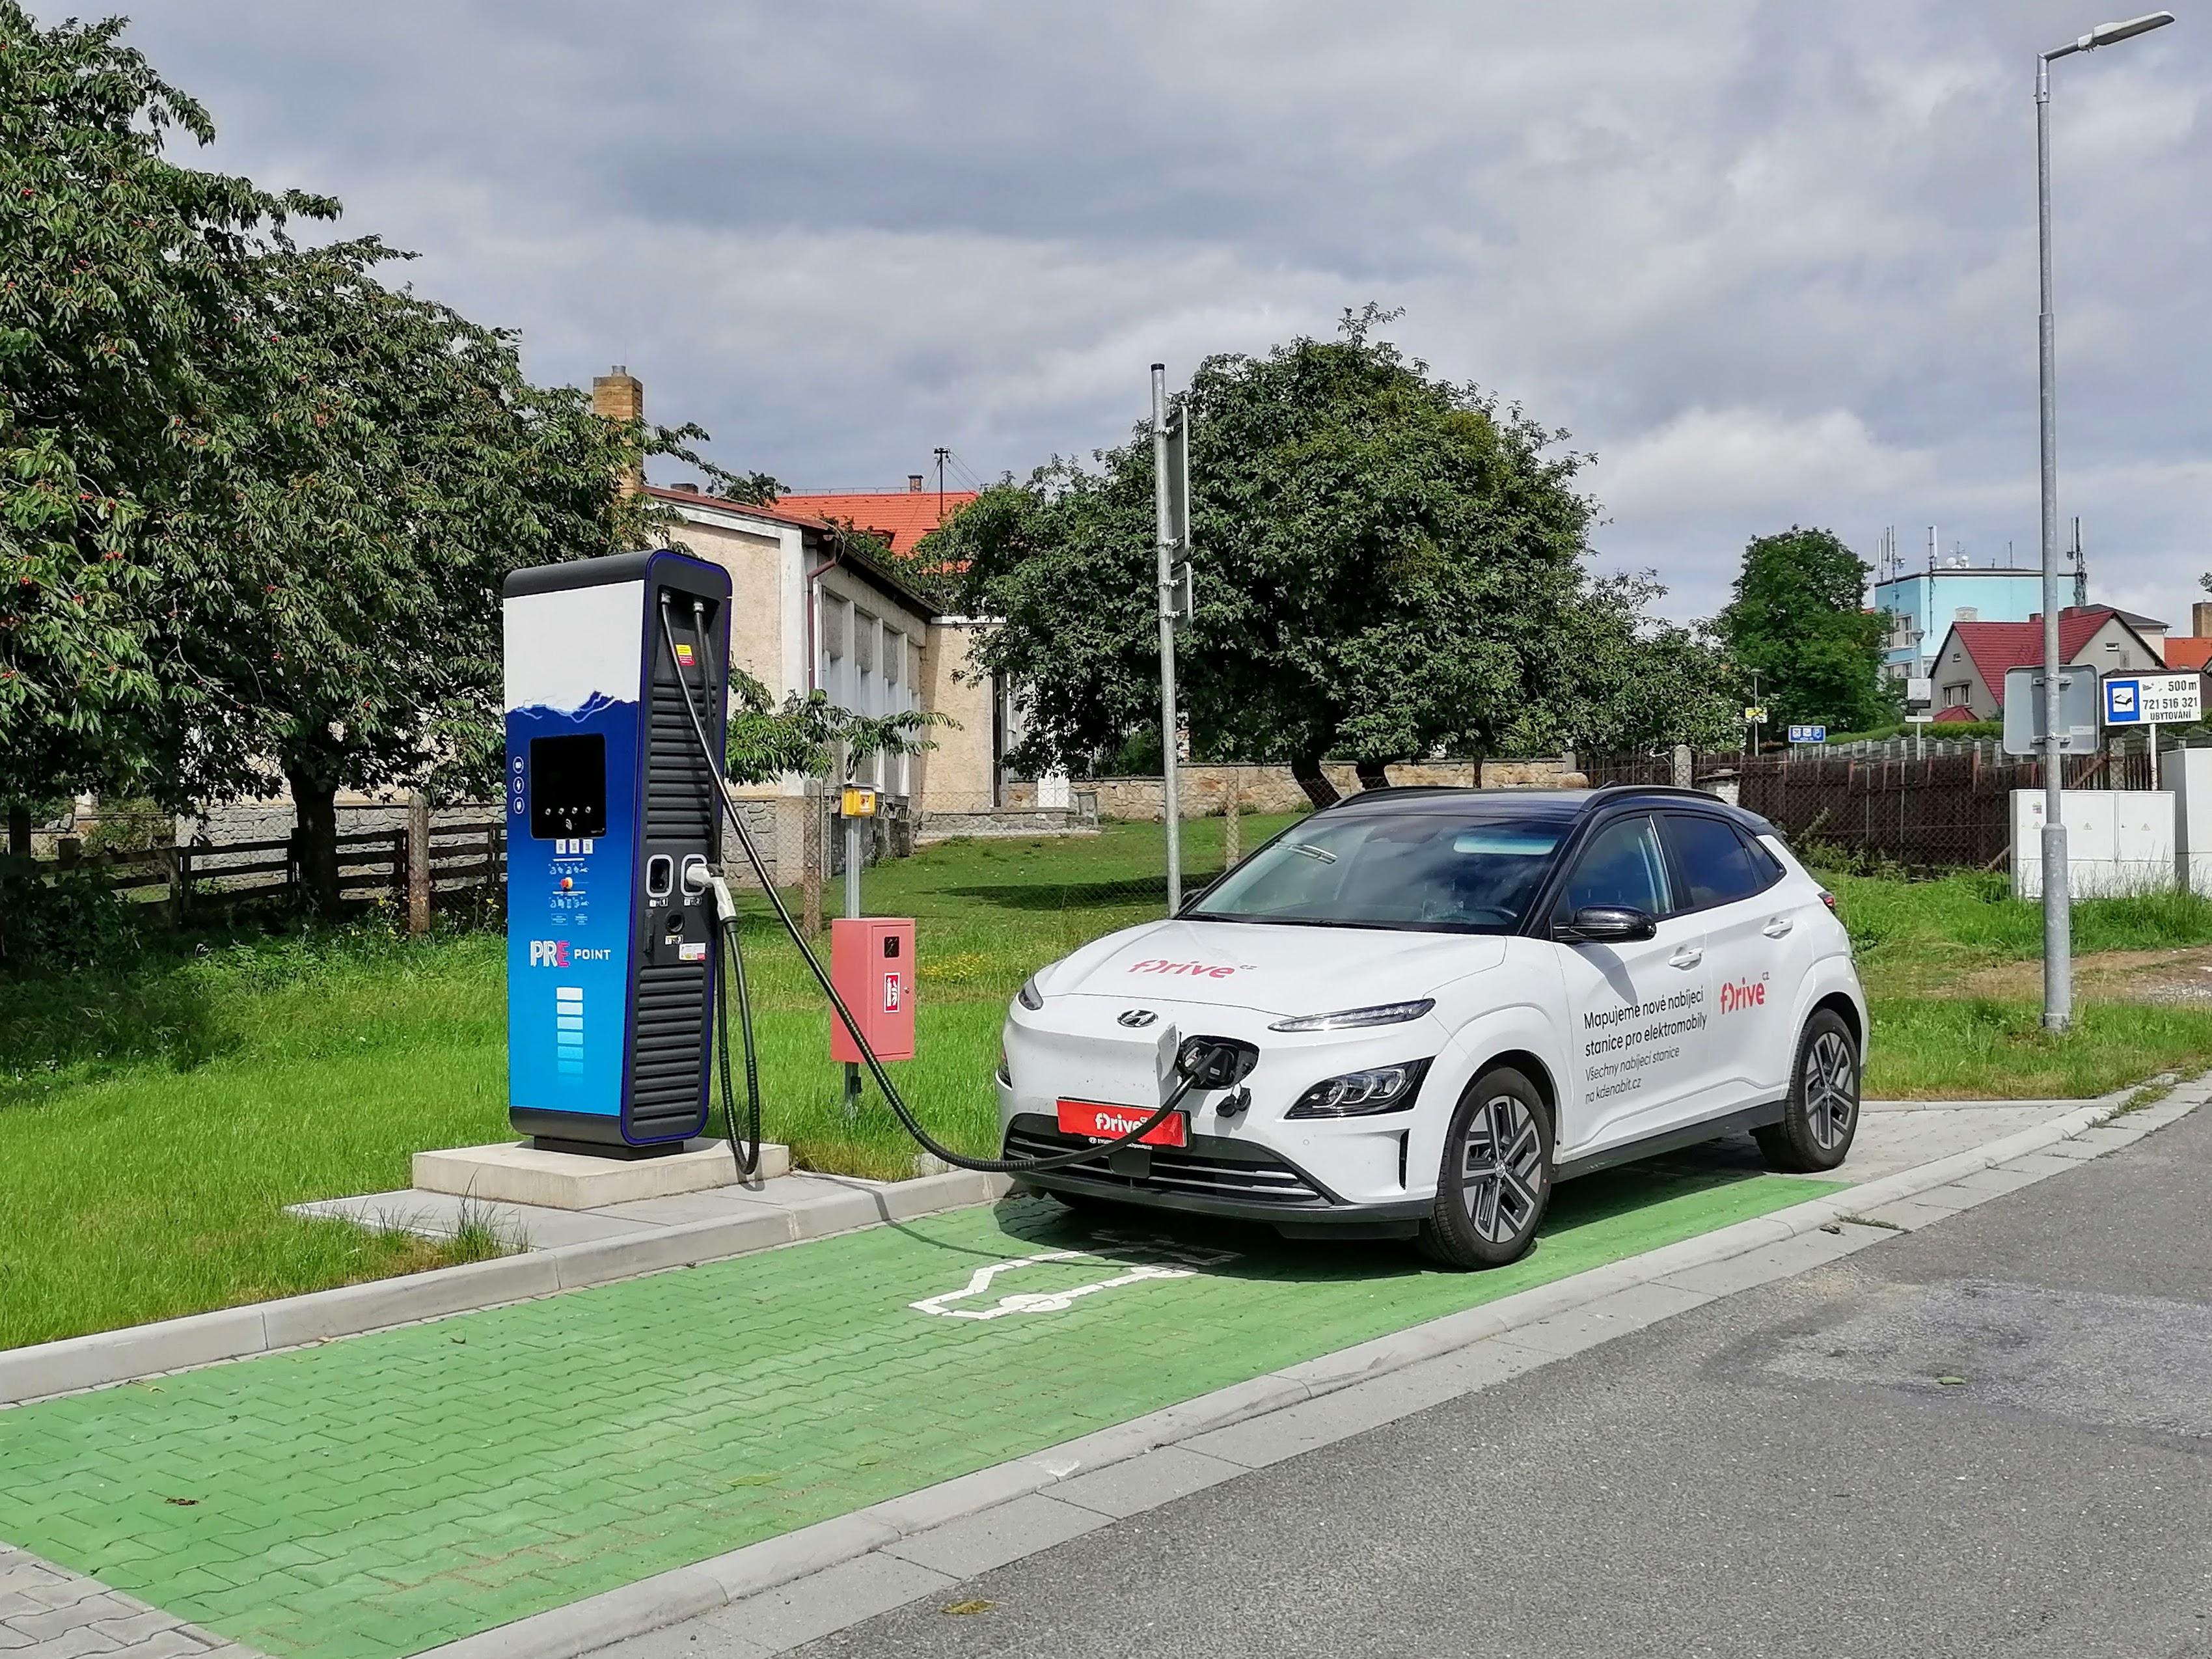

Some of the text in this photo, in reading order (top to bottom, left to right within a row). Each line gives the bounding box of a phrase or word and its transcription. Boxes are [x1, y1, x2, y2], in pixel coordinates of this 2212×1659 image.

[2168, 680, 2197, 692] 500 m
[2143, 696, 2198, 710] 721 516 321
[530, 939, 611, 968] PRE POINT
[1583, 1004, 1641, 1030] Mapujeme
[1643, 994, 1667, 1016] nové
[1585, 1011, 1708, 1057] stanice pro elektromobily
[1585, 1062, 1619, 1081] Všechny
[1652, 1046, 1680, 1063] stanice
[1585, 1077, 1642, 1104] na kdenabit.cz
